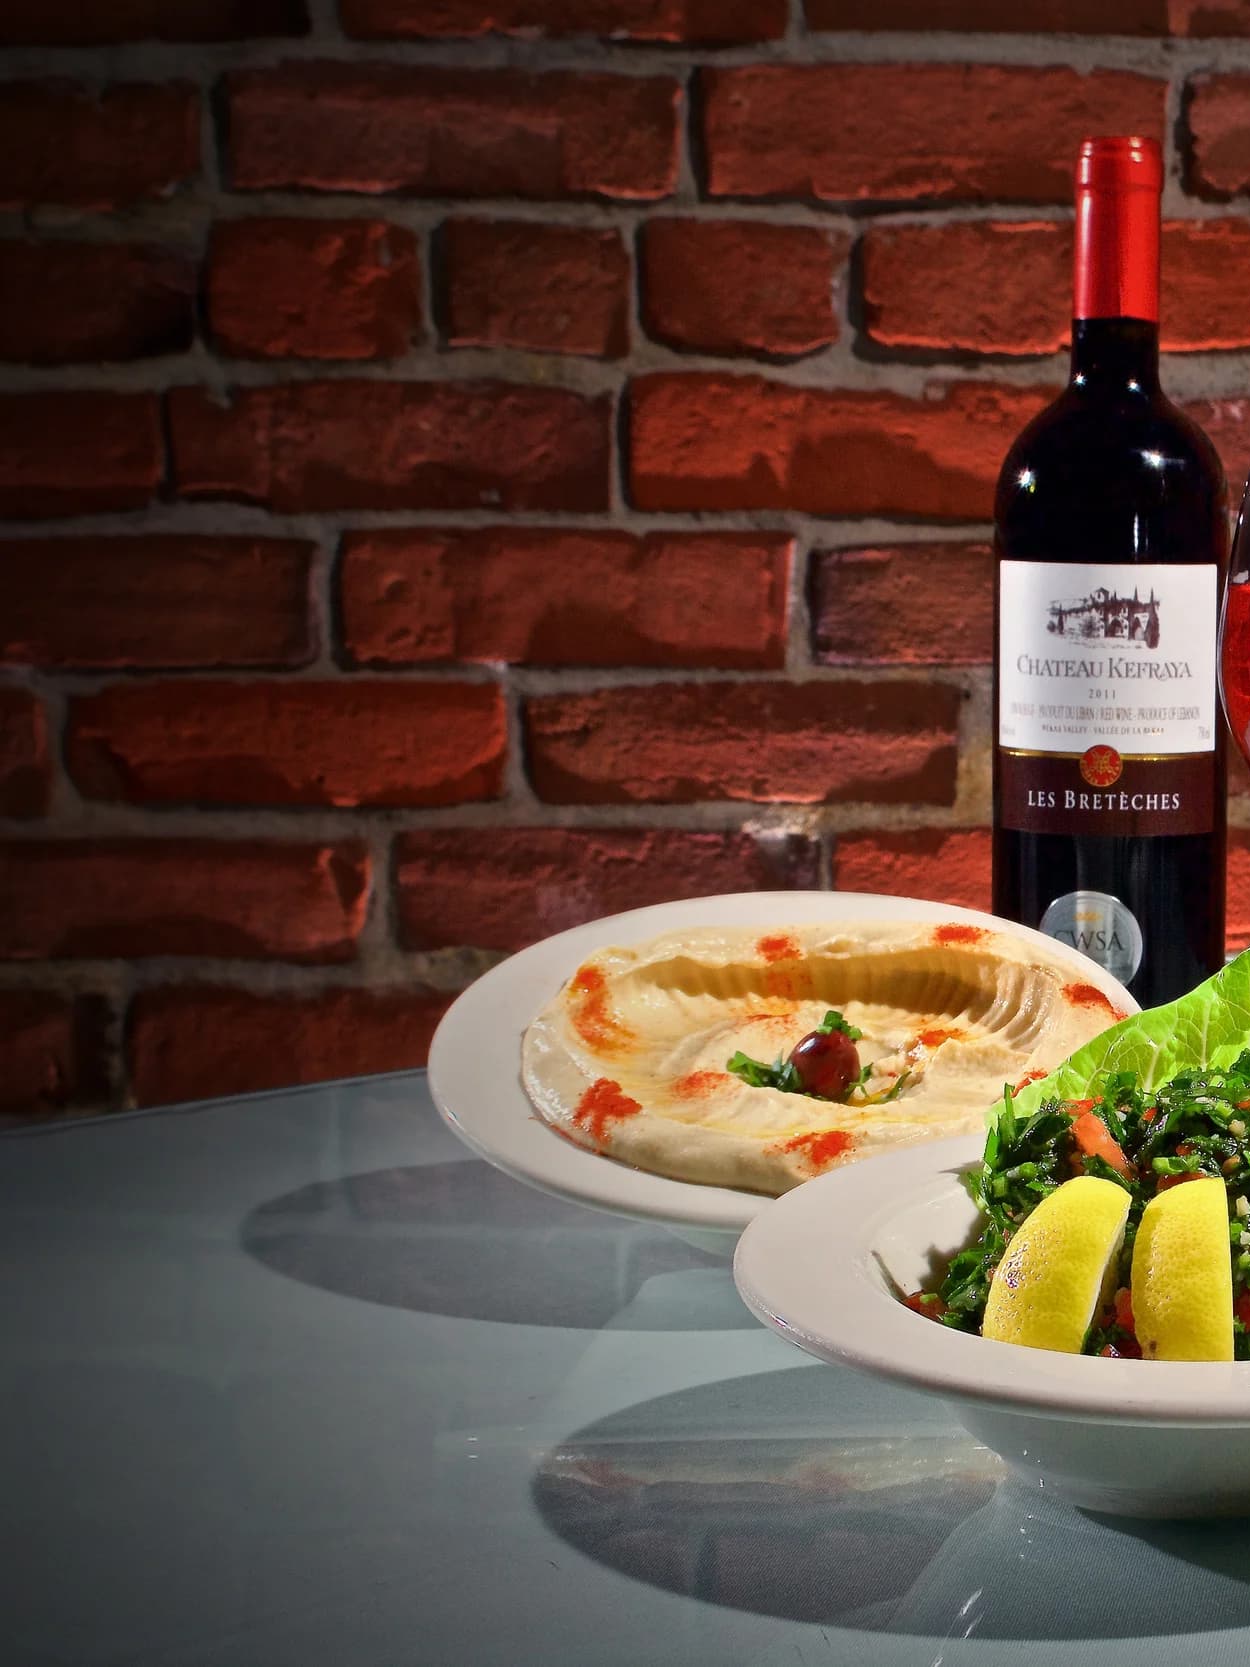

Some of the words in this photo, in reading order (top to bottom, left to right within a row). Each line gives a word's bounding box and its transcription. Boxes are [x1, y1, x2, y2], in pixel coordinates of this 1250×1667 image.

[1017, 654, 1103, 678] CHATEAU
[1108, 657, 1192, 682] KEFRAYA
[1088, 688, 1116, 699] 2011
[1028, 790, 1055, 808] LES
[1064, 790, 1180, 811] BRETÈCHES
